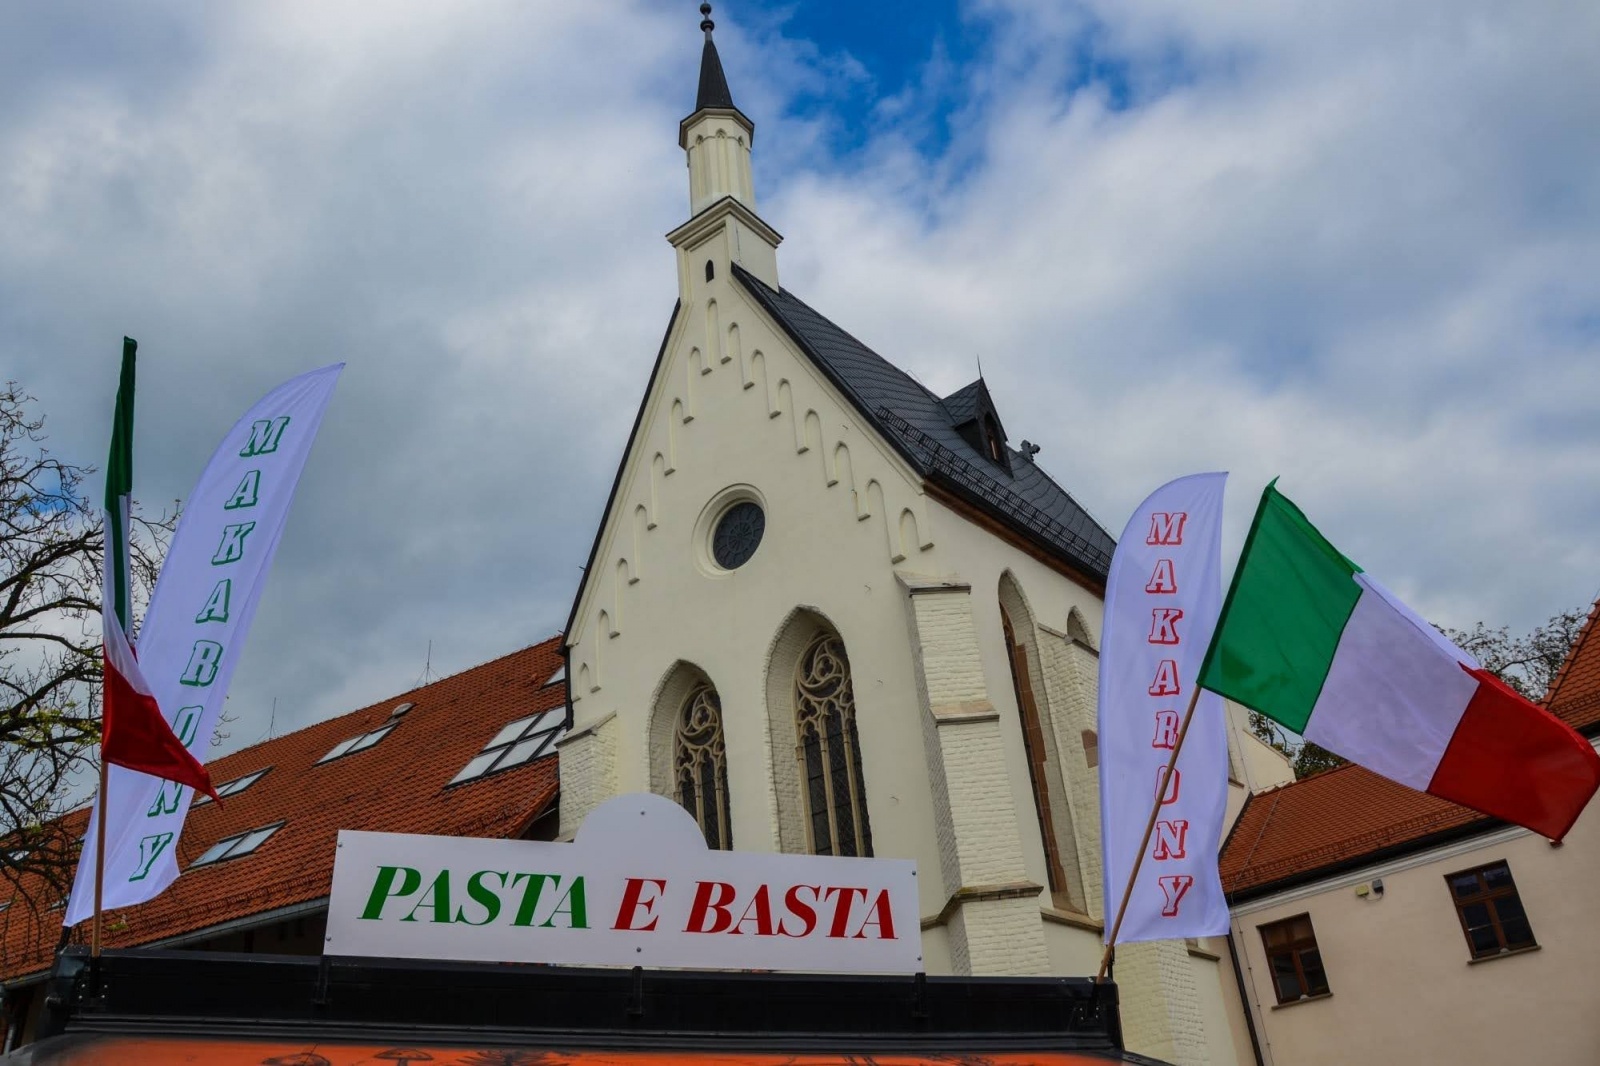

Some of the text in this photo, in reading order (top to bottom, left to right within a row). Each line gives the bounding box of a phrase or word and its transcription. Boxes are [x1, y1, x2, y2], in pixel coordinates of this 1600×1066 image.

[128, 415, 291, 882] MAKARONY
[1146, 512, 1193, 918] MAKARONY
[357, 866, 899, 941] PASTA E BASTA
